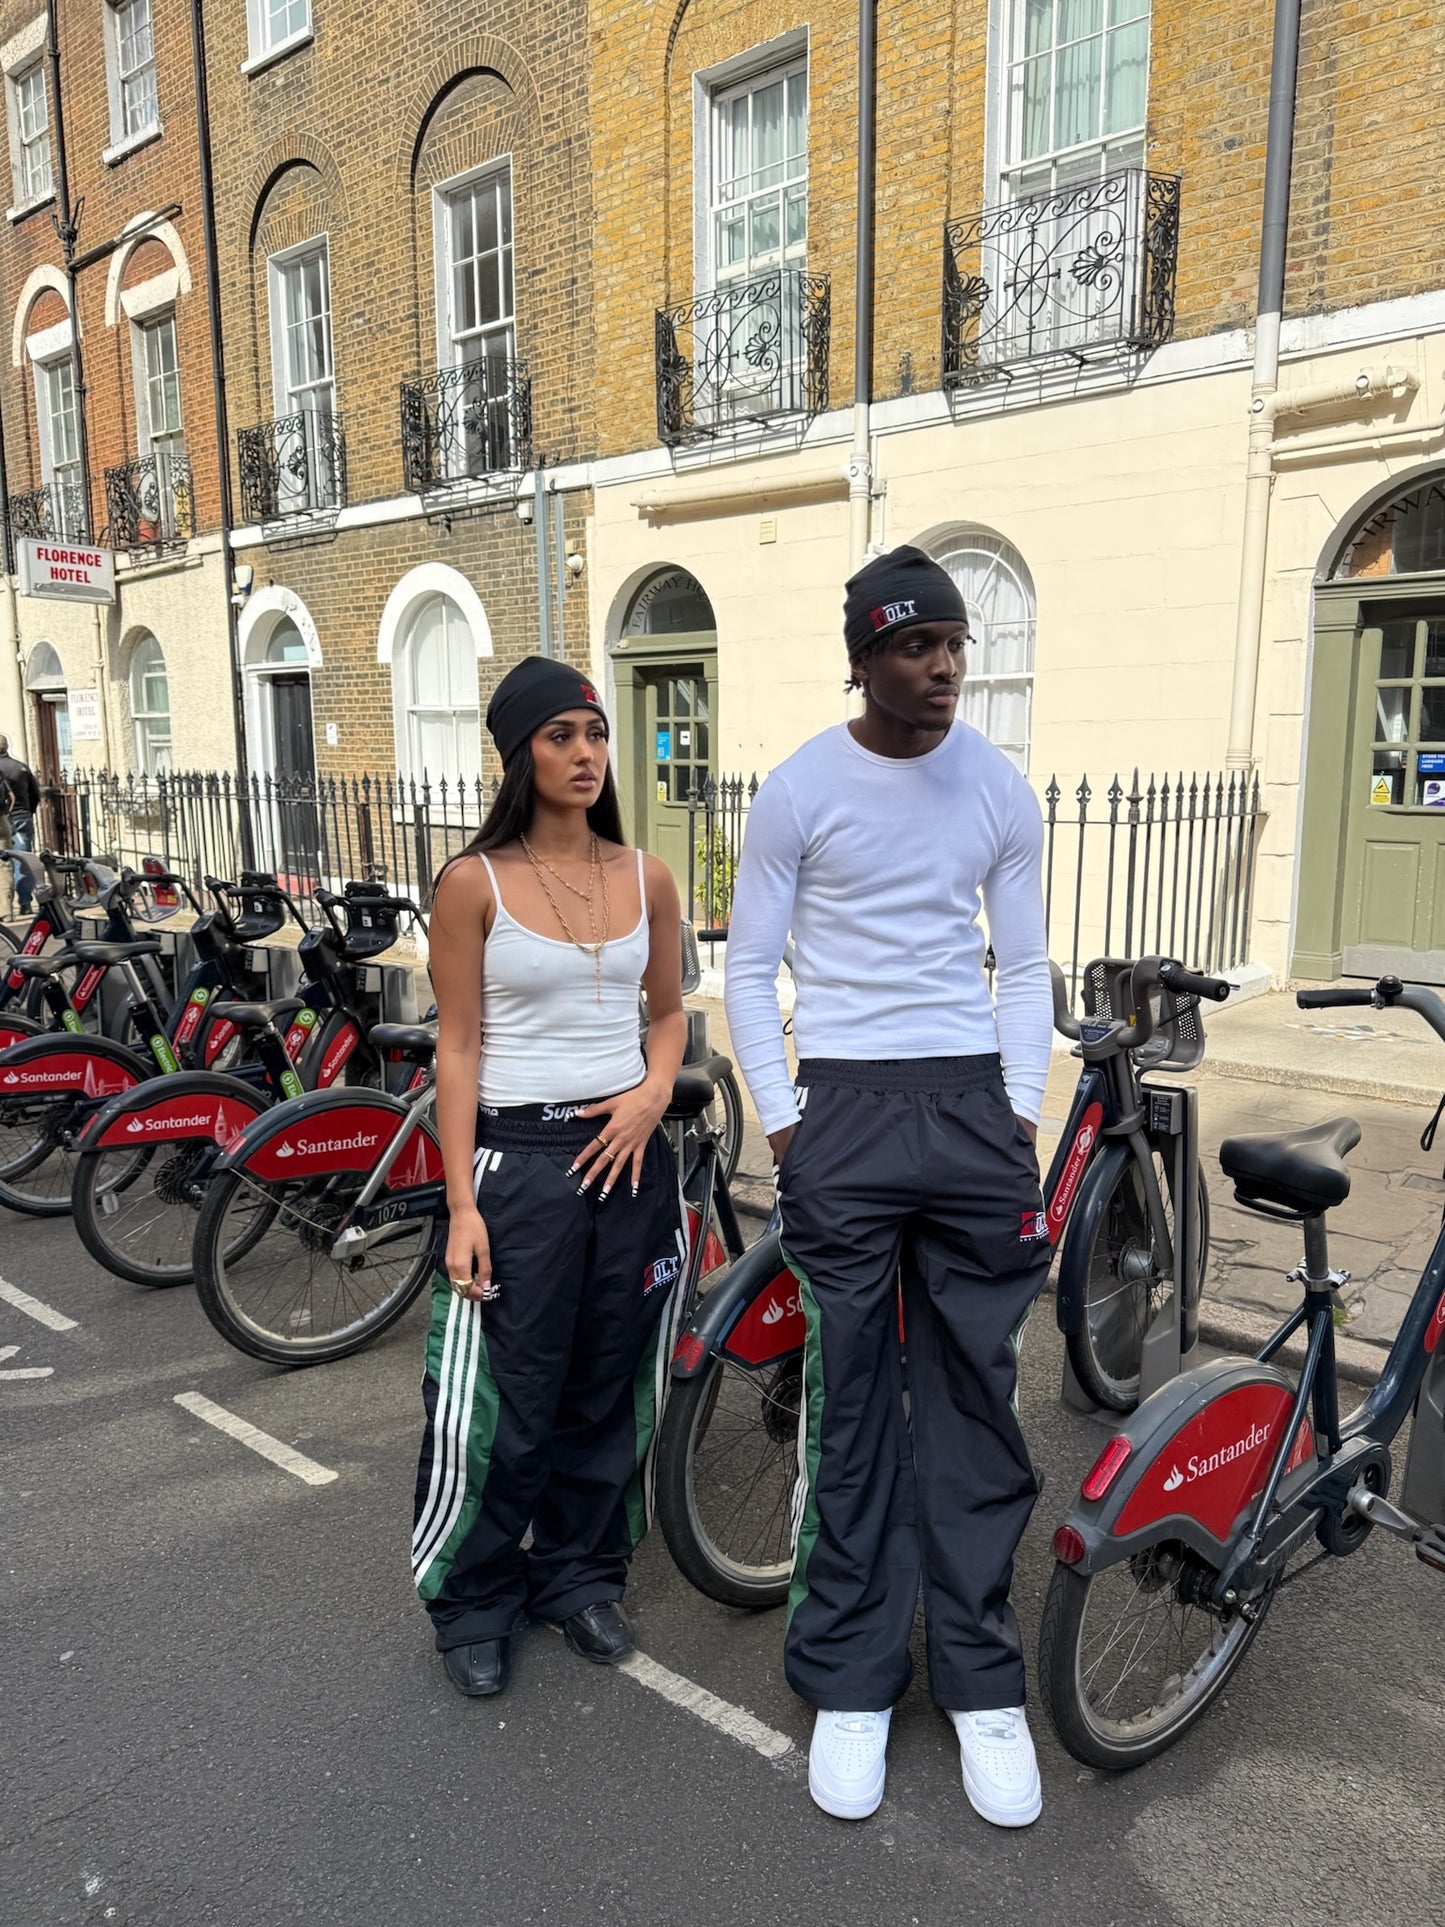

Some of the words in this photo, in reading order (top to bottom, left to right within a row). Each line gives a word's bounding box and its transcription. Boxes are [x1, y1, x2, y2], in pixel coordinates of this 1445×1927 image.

[37, 547, 102, 567] FLORENCE
[50, 567, 91, 584] HOTEL
[632, 576, 683, 628] FAIRWAY
[328, 1034, 354, 1069] Santander
[20, 1070, 83, 1083] Santander
[145, 1114, 212, 1131] Santander
[296, 1131, 378, 1156] Santander
[1059, 1156, 1082, 1205] Santander
[378, 1201, 408, 1225] 1079
[1186, 1422, 1270, 1482] Santander
